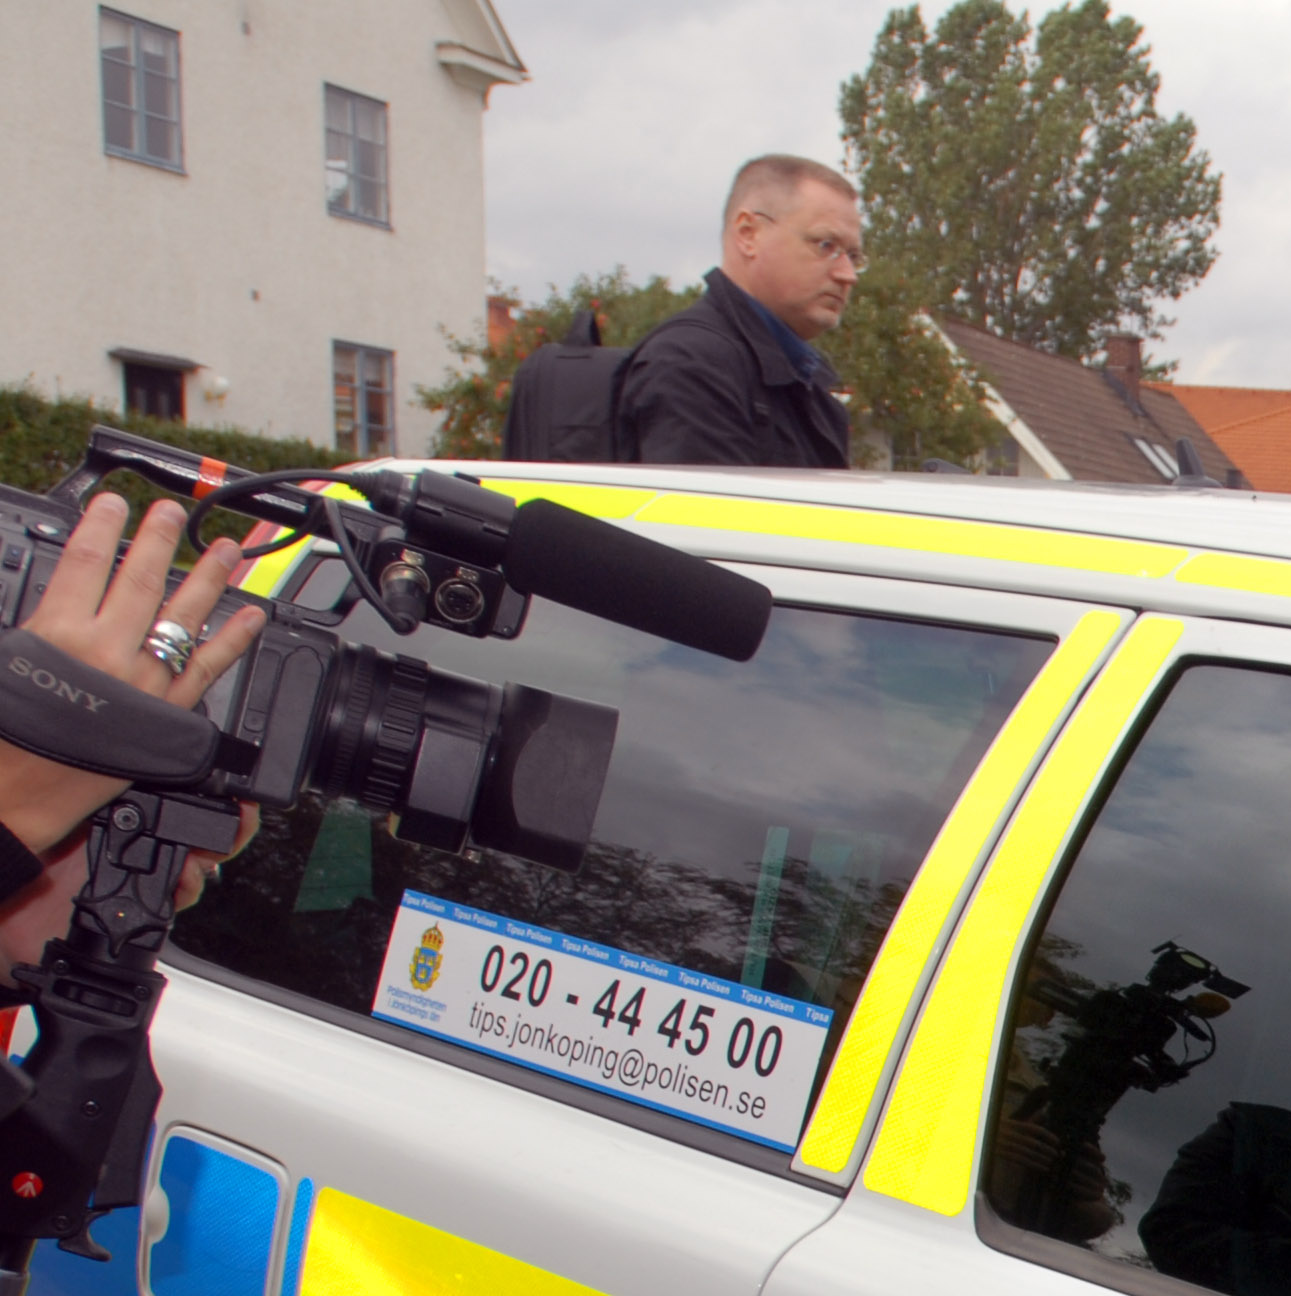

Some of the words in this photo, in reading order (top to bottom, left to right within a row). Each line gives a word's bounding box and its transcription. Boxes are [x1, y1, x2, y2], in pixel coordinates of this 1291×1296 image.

[8, 656, 110, 713] SONY
[468, 1001, 766, 1120] tips.jonkoping@polisen.se
[480, 944, 553, 1007] 020
[565, 993, 580, 1005] -
[592, 979, 646, 1036] 44
[657, 998, 716, 1056] 45
[726, 1017, 784, 1077] 00
